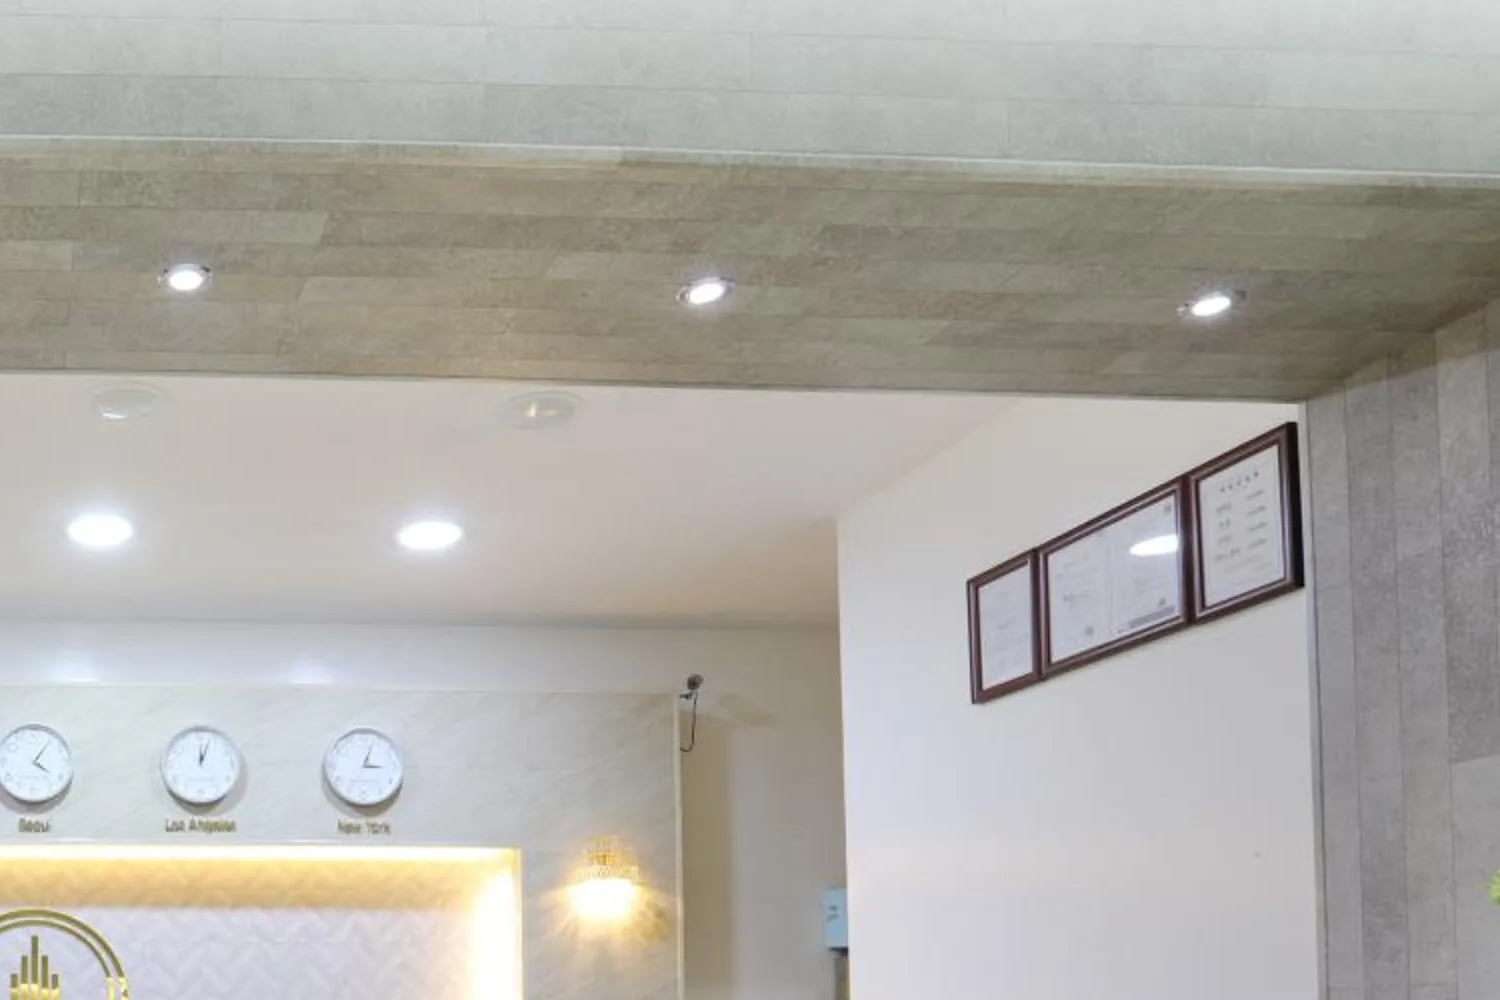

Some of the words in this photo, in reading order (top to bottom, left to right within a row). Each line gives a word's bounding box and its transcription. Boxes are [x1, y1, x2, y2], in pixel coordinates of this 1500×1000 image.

[18, 818, 51, 833] Seoul
[165, 818, 185, 833] Los
[365, 820, 391, 835] York
